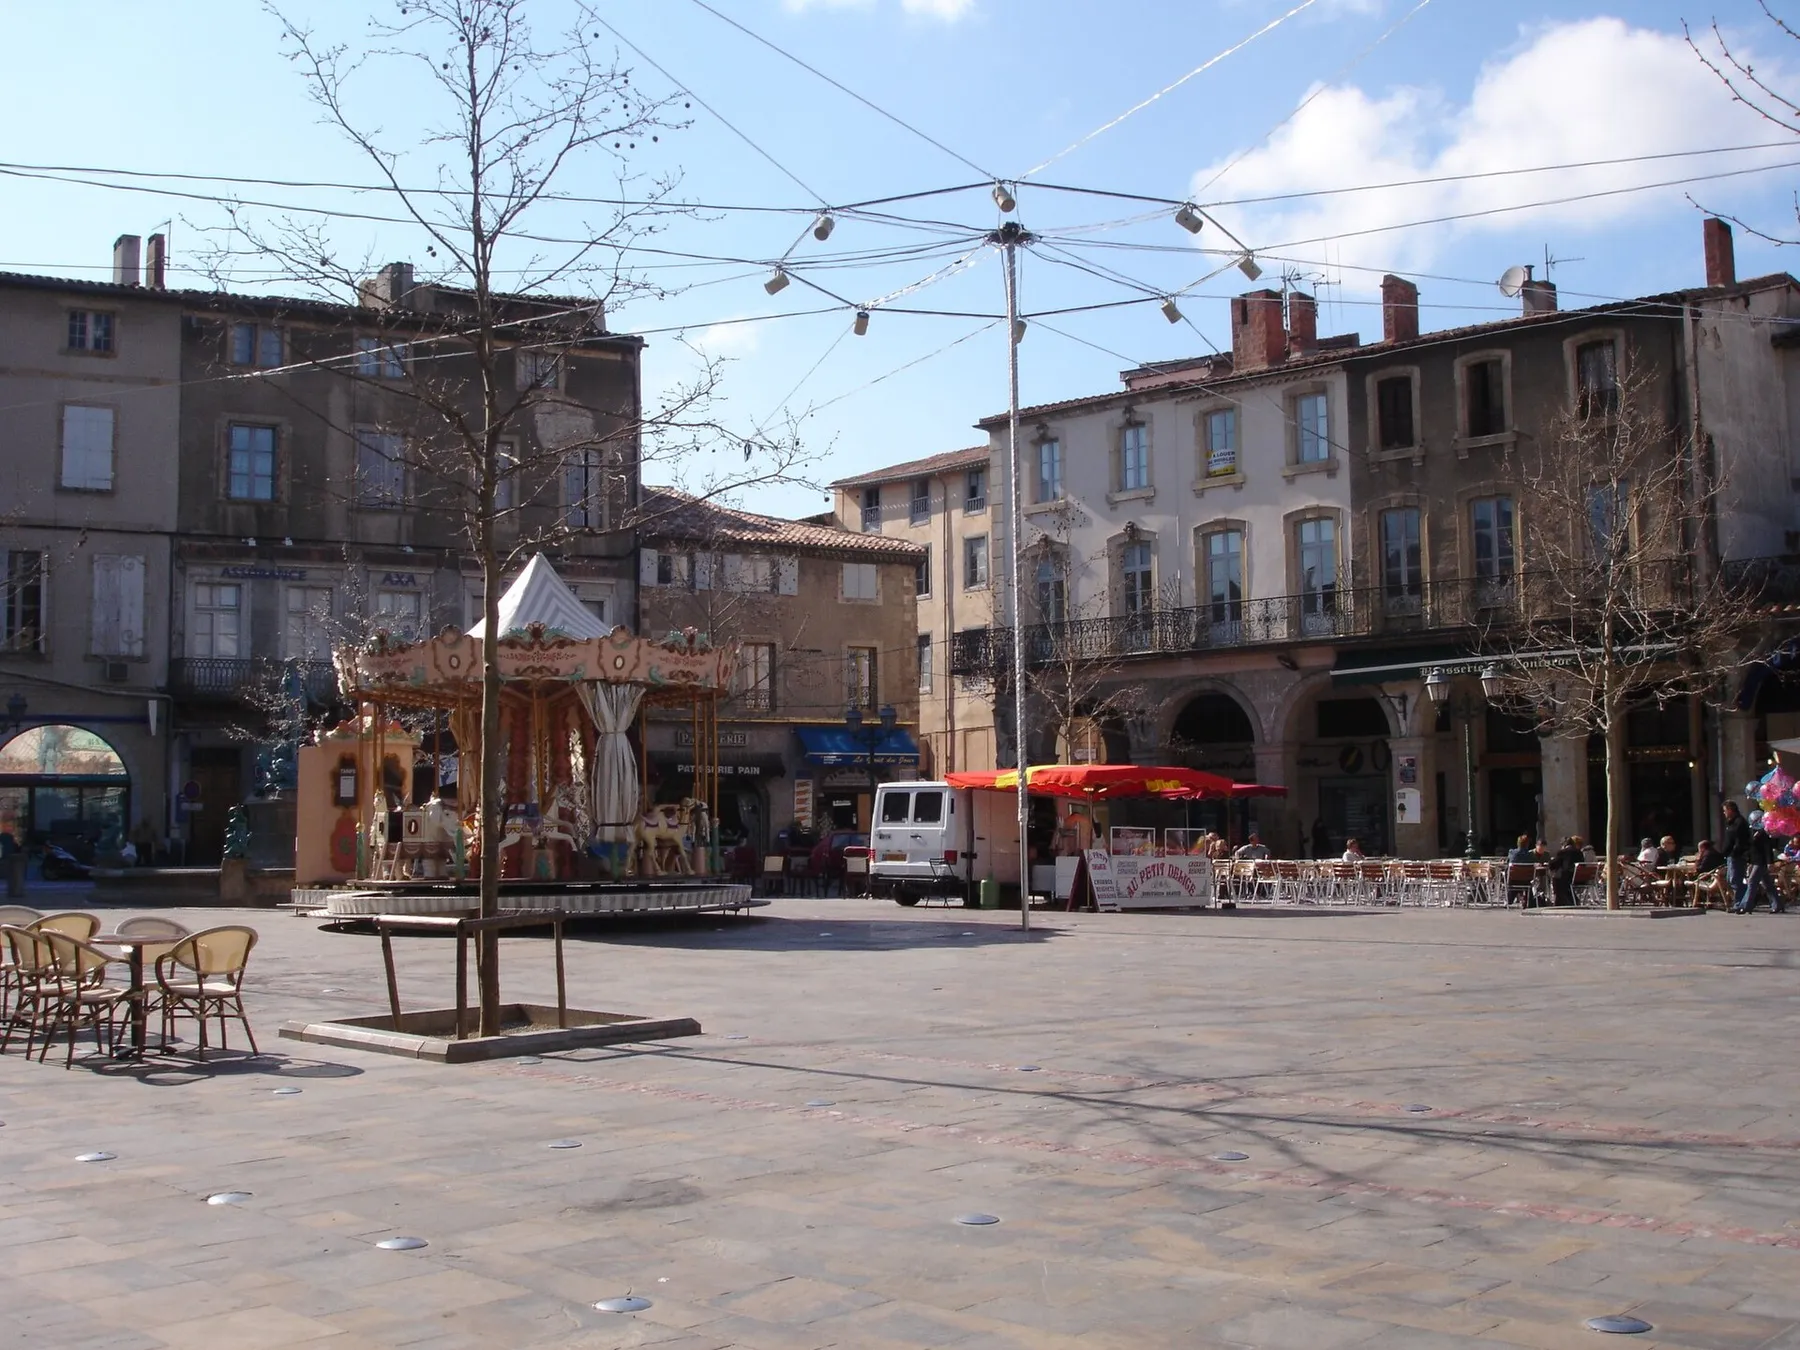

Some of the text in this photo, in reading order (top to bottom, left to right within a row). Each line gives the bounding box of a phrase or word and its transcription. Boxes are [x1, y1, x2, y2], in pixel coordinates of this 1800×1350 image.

[382, 572, 416, 587] AXA
[738, 766, 760, 775] PAIN
[1126, 877, 1139, 898] AU
[1139, 862, 1166, 884] PETIT
